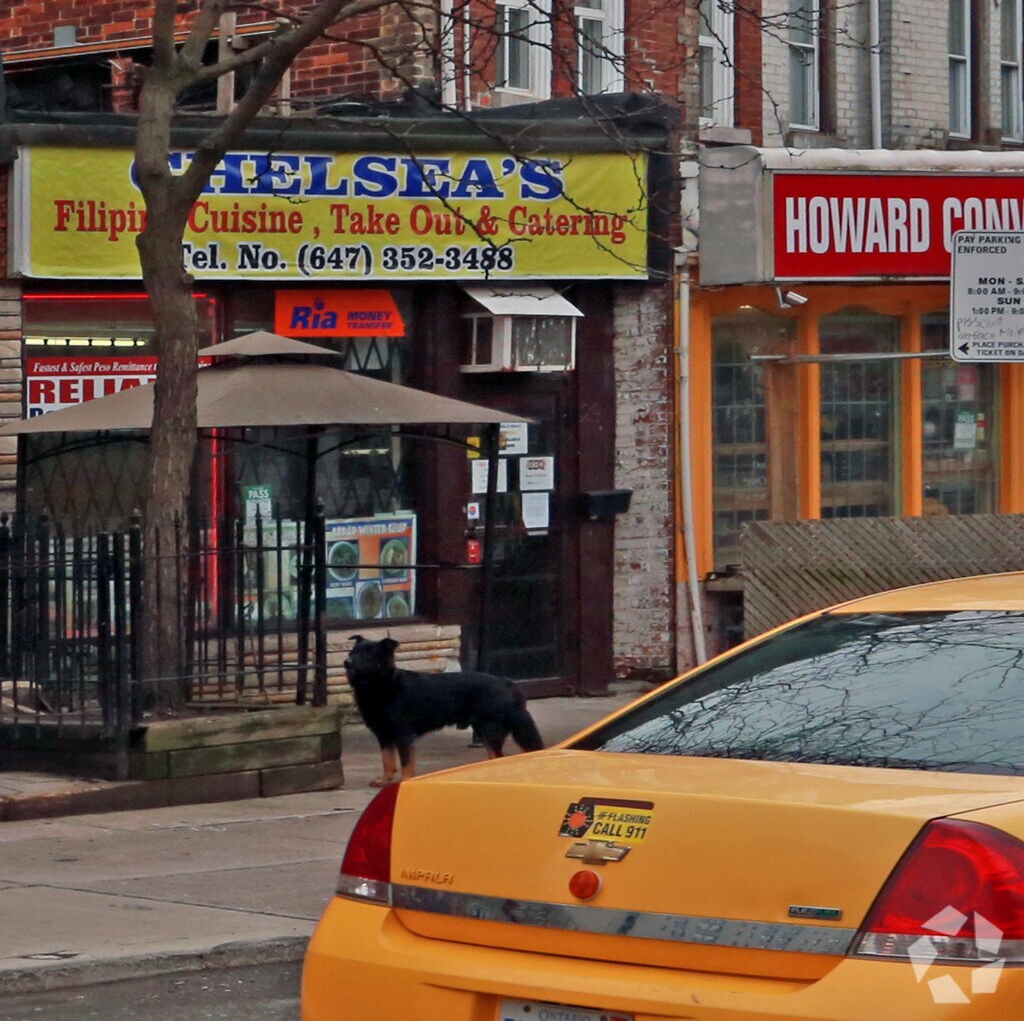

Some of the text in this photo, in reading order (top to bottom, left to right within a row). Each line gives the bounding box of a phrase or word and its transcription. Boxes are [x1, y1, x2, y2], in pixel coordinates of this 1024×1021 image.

[187, 201, 304, 234] Cuisine
[330, 203, 400, 235] Take
[410, 204, 466, 236] Out
[479, 205, 498, 236] &
[508, 205, 629, 244] Catering
[786, 196, 930, 254] HOWARD
[957, 235, 1021, 244] PAY PARKING
[957, 245, 1007, 254] ENFORCED
[180, 243, 514, 276] Tel. No. (647) 352-3488
[978, 277, 1005, 286] MON
[1016, 277, 1024, 286] S
[967, 287, 988, 295] 8:00
[990, 287, 1006, 295] AM
[997, 297, 1021, 305] SUN
[290, 298, 337, 329] Ria
[347, 311, 392, 321] MONEY
[972, 307, 990, 315] 1:00
[991, 307, 1005, 315] PM
[347, 321, 393, 330] TRANSFER
[33, 363, 60, 373] Fastest
[69, 362, 93, 375] Safest
[94, 361, 112, 372] Peso
[112, 361, 153, 372] Remittance
[248, 489, 270, 500] PASS
[608, 812, 651, 825] FLASHING
[592, 822, 648, 839] CALL 911
